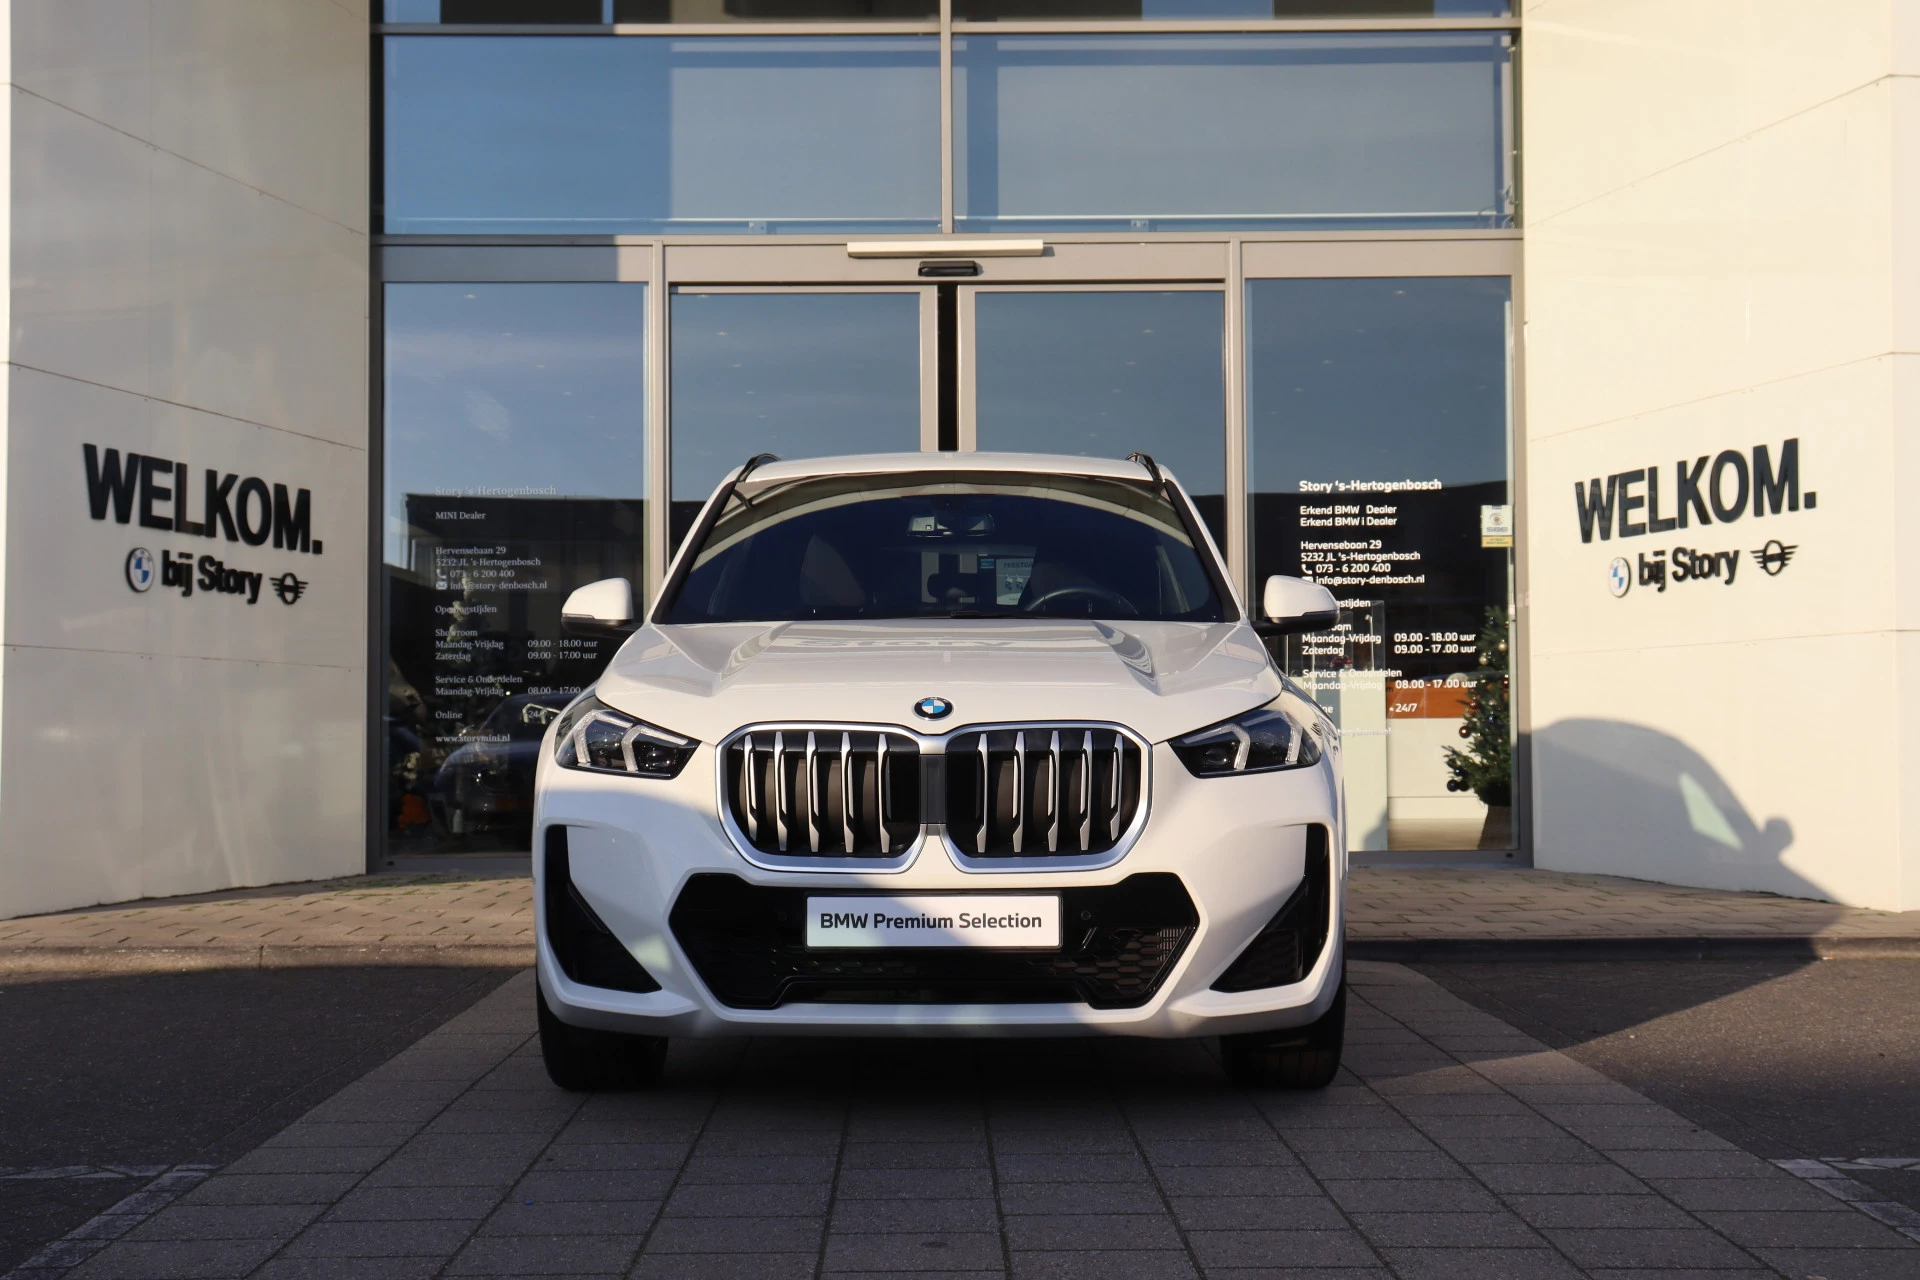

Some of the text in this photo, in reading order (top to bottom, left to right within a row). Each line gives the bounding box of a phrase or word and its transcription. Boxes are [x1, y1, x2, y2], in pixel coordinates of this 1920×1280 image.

[1299, 480, 1333, 493] Story
[1575, 437, 1817, 544] WELKOM.
[435, 486, 462, 498] Story
[83, 443, 323, 554] WELKOM.
[1300, 505, 1397, 515] Erkend BMW Dealer
[435, 511, 486, 520] MINI Dealer
[1300, 517, 1397, 527] Erkend BMW i Dealer
[1300, 540, 1382, 550] Hervensebaan 29
[435, 546, 507, 555] Hervensebaan 29
[1301, 553, 1324, 562] 5232
[1326, 553, 1337, 561] JL
[436, 559, 456, 567] 5232
[1316, 564, 1334, 573] 073
[1342, 564, 1349, 572] 6
[1350, 564, 1370, 572] 200
[1371, 563, 1391, 572] 400
[473, 570, 479, 578] 6
[481, 570, 497, 578] 200
[499, 570, 515, 578] 400
[1638, 547, 1740, 592] bij Story
[162, 550, 263, 604] bij Story
[1316, 575, 1425, 586] info@story-denbosch.nl
[1302, 633, 1382, 645] Maandag-Vrijdag
[1394, 633, 1423, 643] 09.00
[1431, 633, 1458, 642] 18.00
[1460, 634, 1476, 642] uur
[435, 640, 504, 650] Maandag-Vrijdag
[527, 640, 551, 648] 09.00
[559, 639, 581, 647] 18.00
[1302, 645, 1344, 656] Zaterdag
[1394, 645, 1423, 654] 09.00
[435, 652, 471, 661] Zaterdag
[527, 651, 551, 659] 09.00
[559, 651, 581, 659] 17.00
[1302, 669, 1337, 678] Service
[1349, 668, 1402, 678] Onderdelen
[435, 675, 523, 684] Service & Onderdelen
[1395, 680, 1424, 689] 08.00
[435, 687, 504, 697] Maandag-Vrijdag
[527, 687, 551, 695] 08.00
[1395, 703, 1417, 713] 24/7
[435, 711, 463, 719] Online
[435, 733, 511, 743] www.storymini.nl
[820, 912, 1042, 928] BMW Premium Selection
